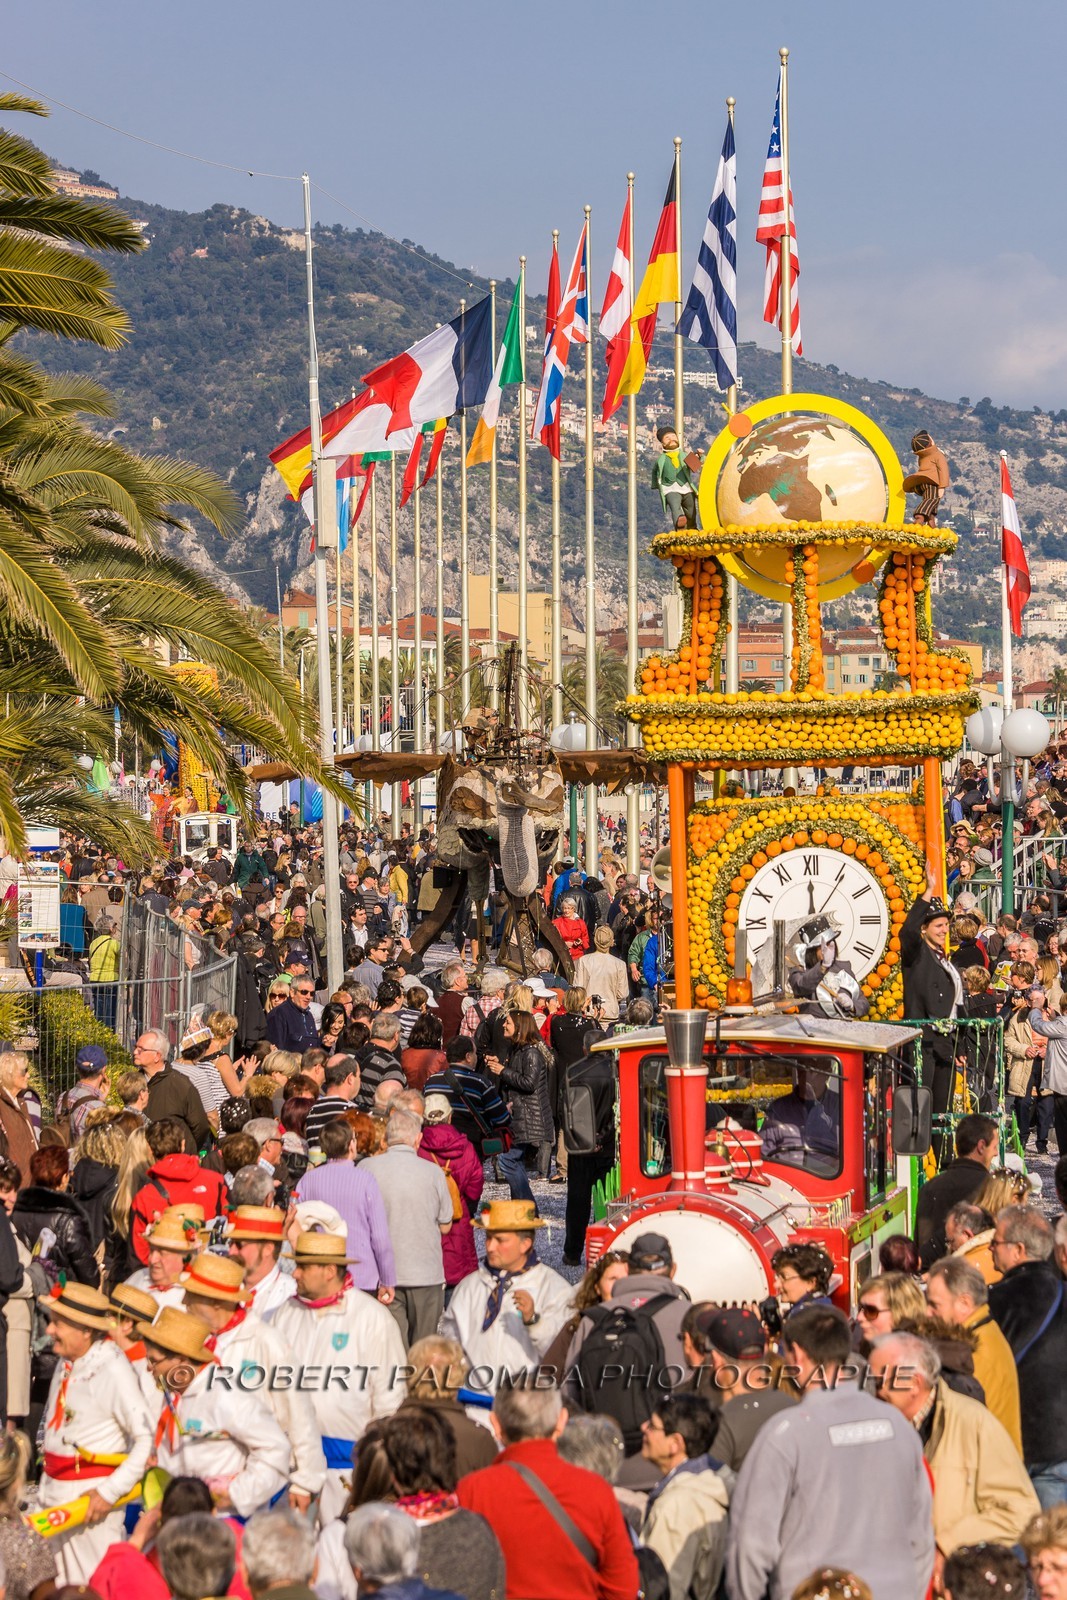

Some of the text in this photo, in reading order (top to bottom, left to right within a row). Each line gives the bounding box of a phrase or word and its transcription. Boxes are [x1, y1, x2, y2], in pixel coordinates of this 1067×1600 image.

[803, 854, 819, 876] XII
[772, 863, 792, 886] XI
[752, 887, 773, 904] X
[851, 884, 872, 900] II
[745, 916, 767, 931] IX
[860, 915, 881, 925] III
